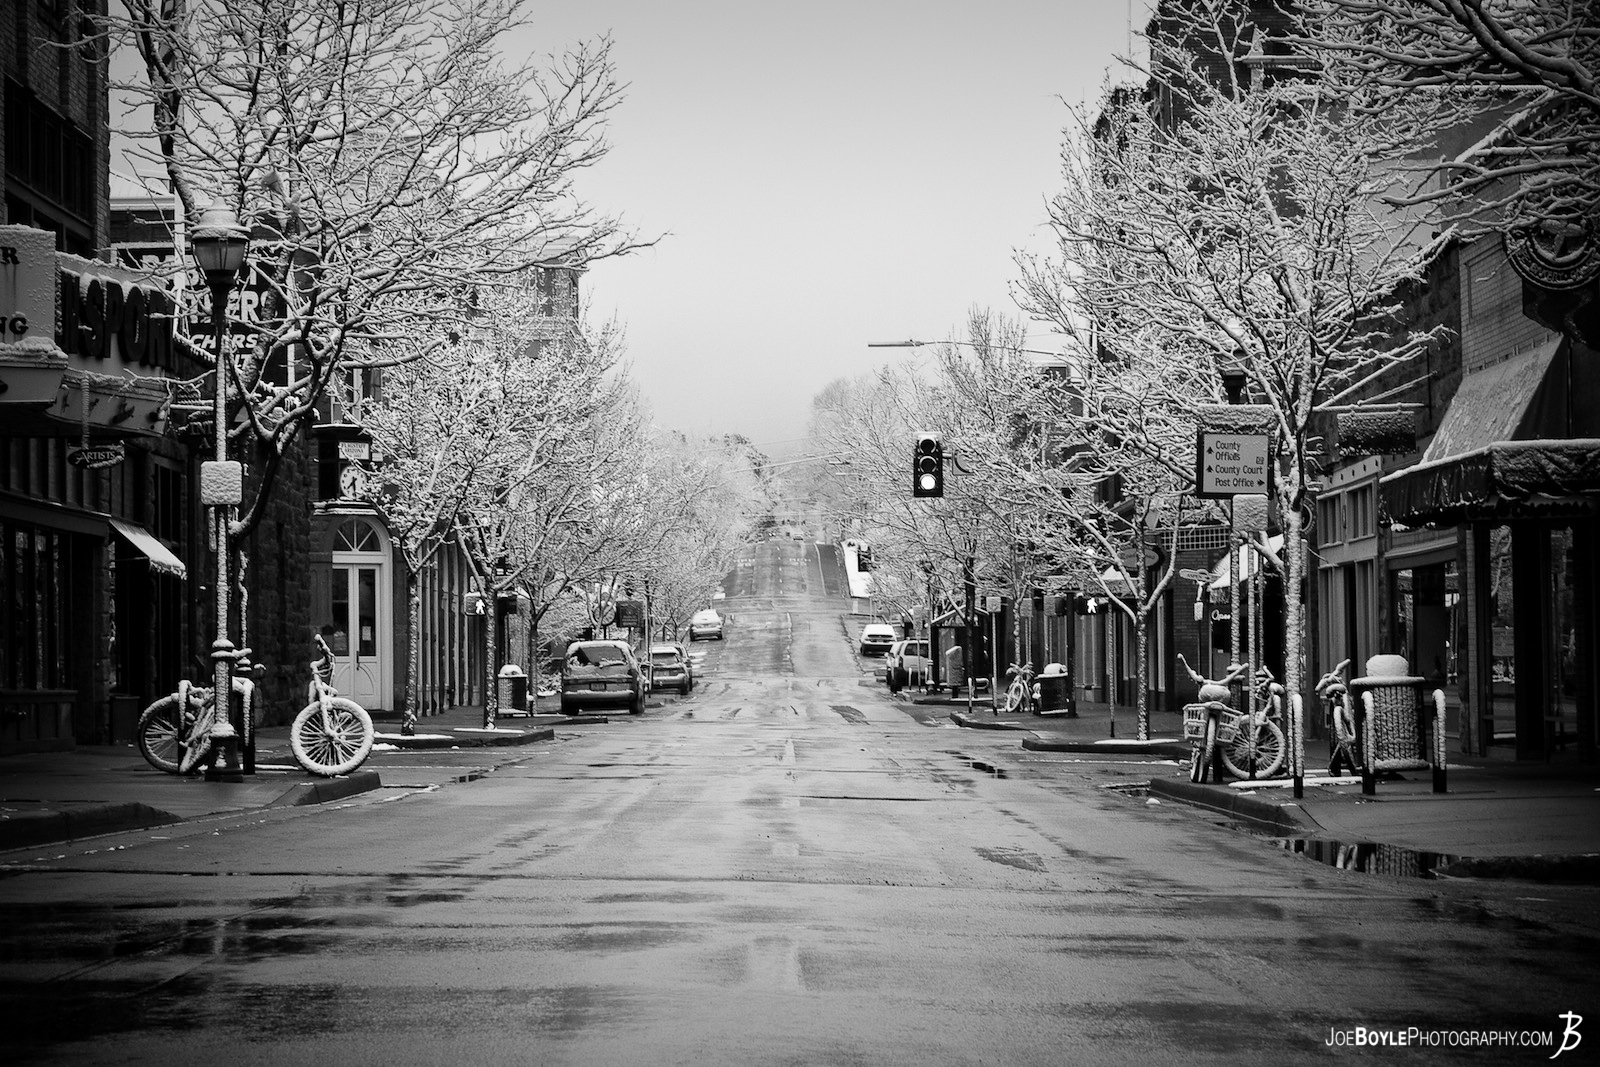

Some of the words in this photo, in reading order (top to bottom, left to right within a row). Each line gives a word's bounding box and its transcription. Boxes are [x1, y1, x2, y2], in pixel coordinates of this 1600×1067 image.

[1215, 440, 1241, 451] County
[75, 450, 116, 465] ARTISTS
[1215, 464, 1241, 476] County
[1242, 465, 1263, 475] Court
[1215, 477, 1231, 487] Post
[1232, 477, 1255, 487] Office
